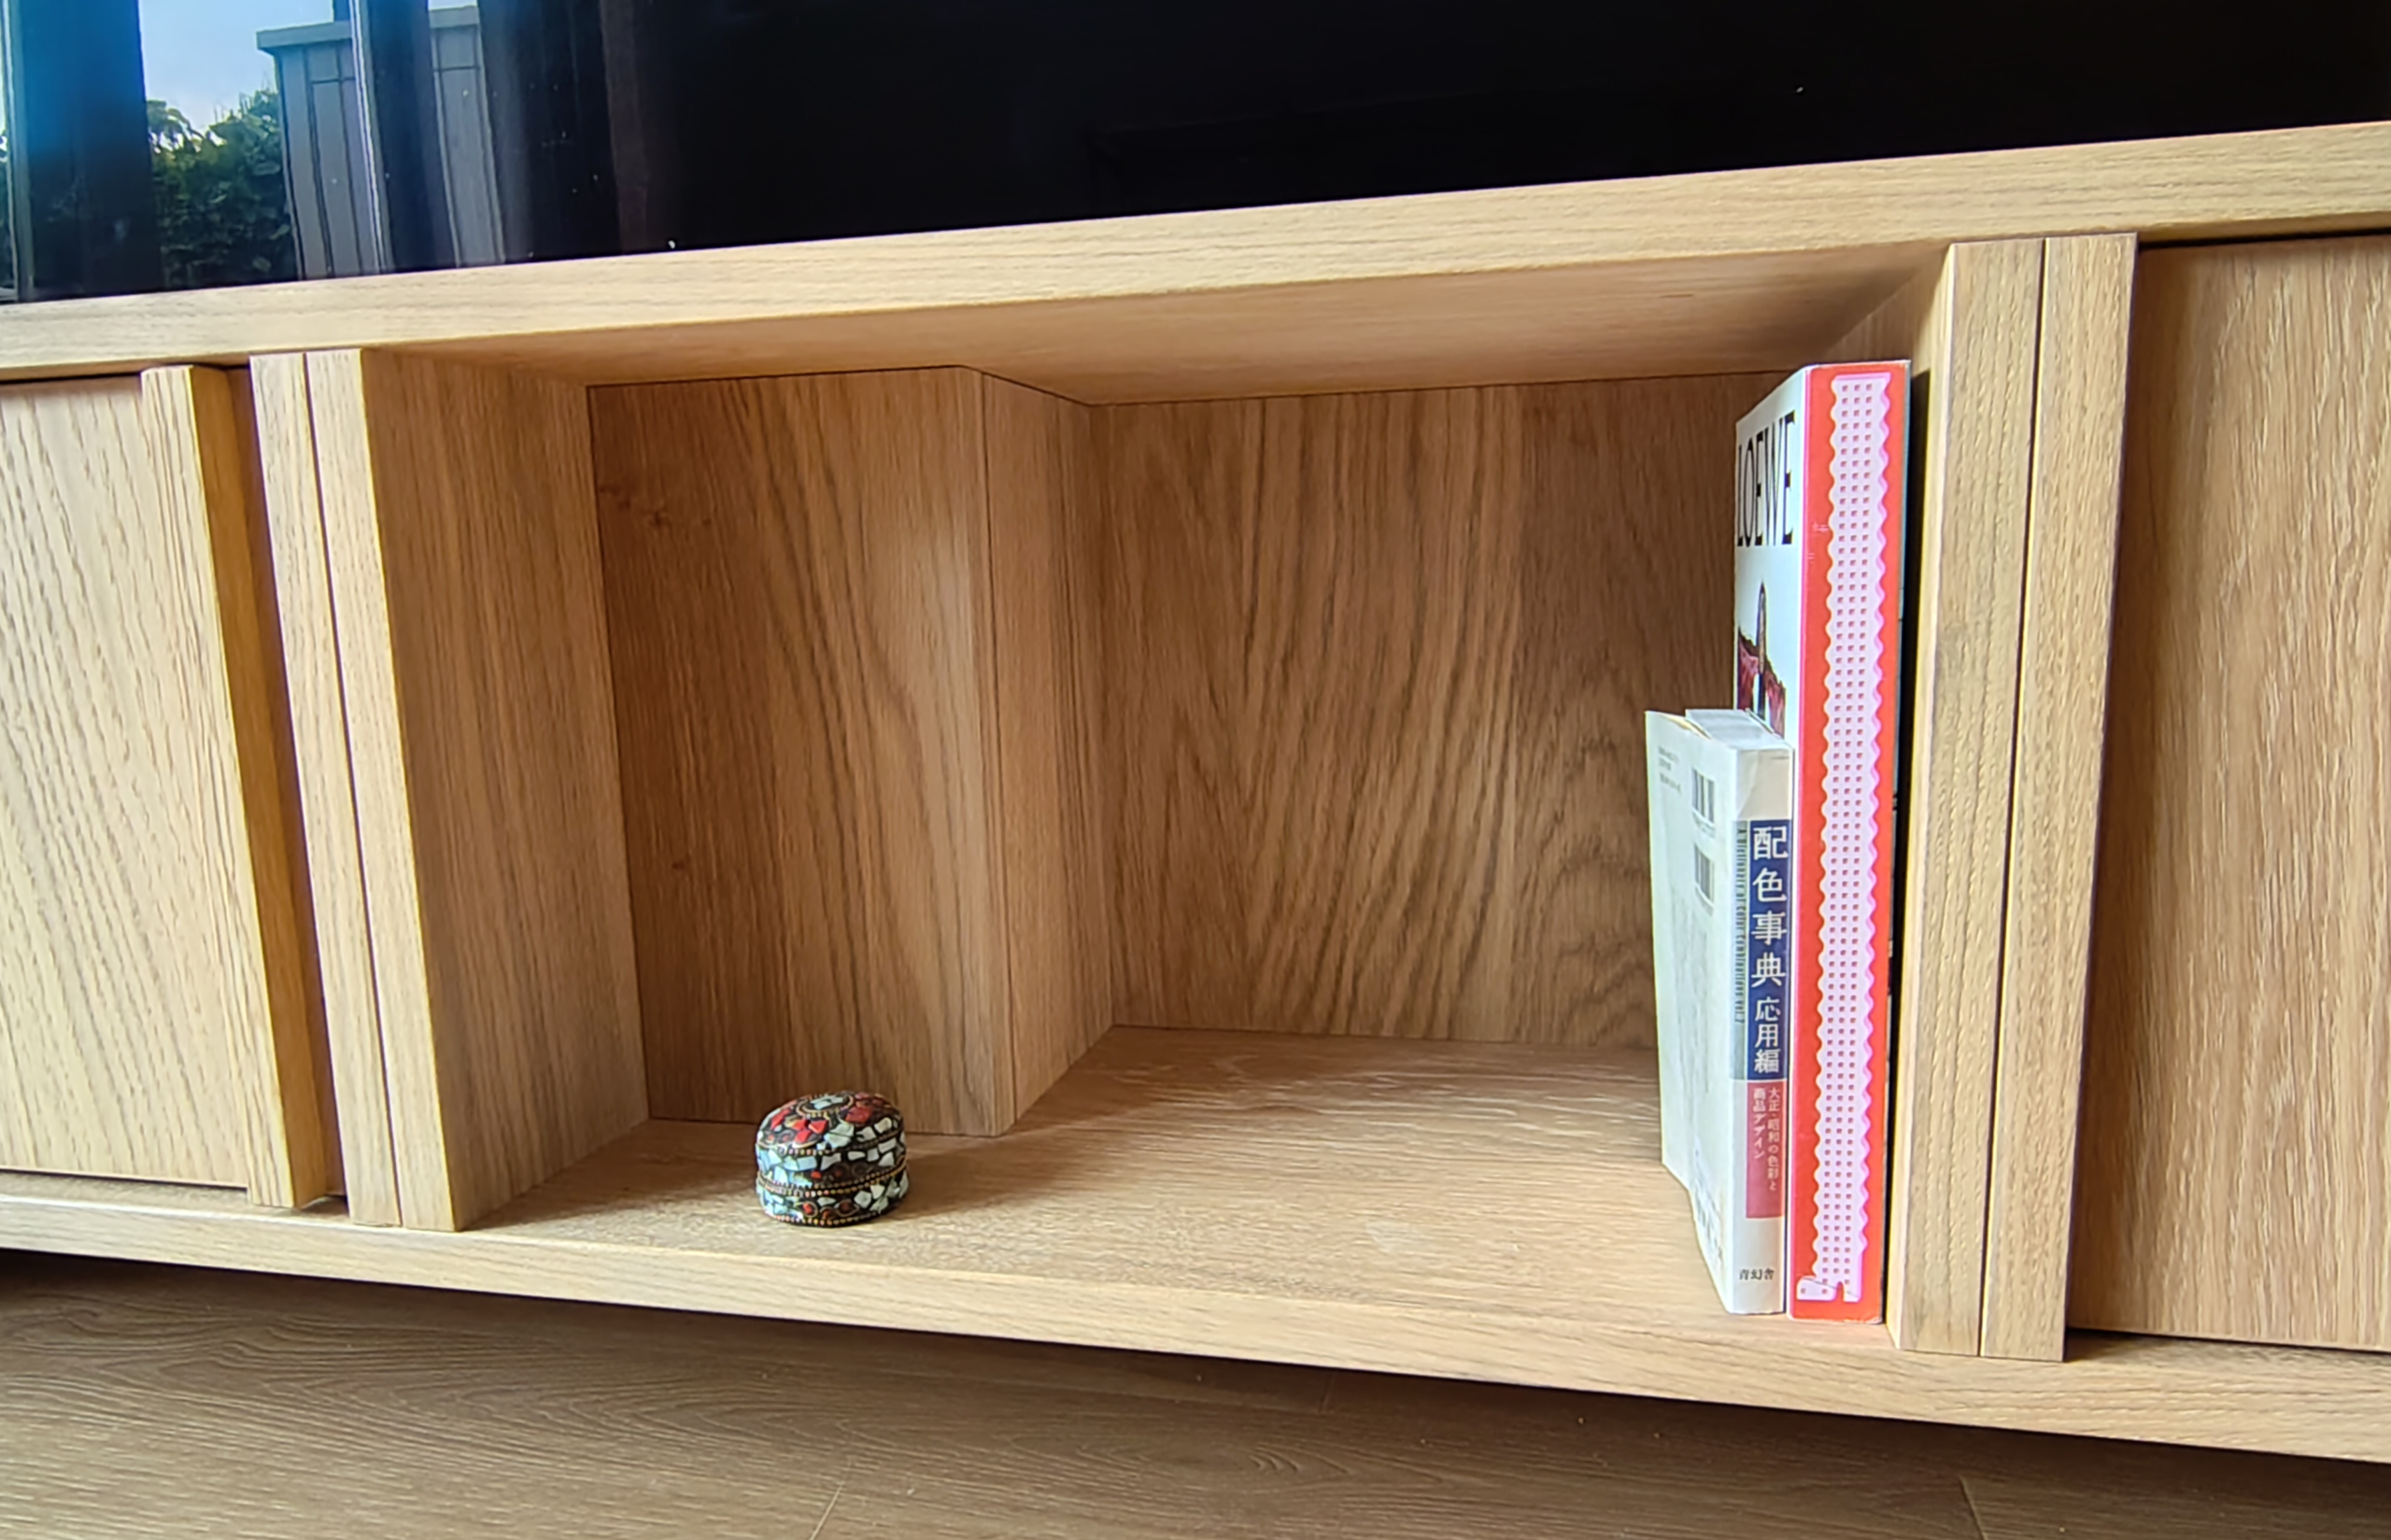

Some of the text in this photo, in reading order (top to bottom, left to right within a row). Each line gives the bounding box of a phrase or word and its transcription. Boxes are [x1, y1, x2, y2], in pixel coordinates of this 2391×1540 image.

[1736, 410, 1795, 547] LOEWE
[1751, 826, 1789, 1074] 配色事典 応用編
